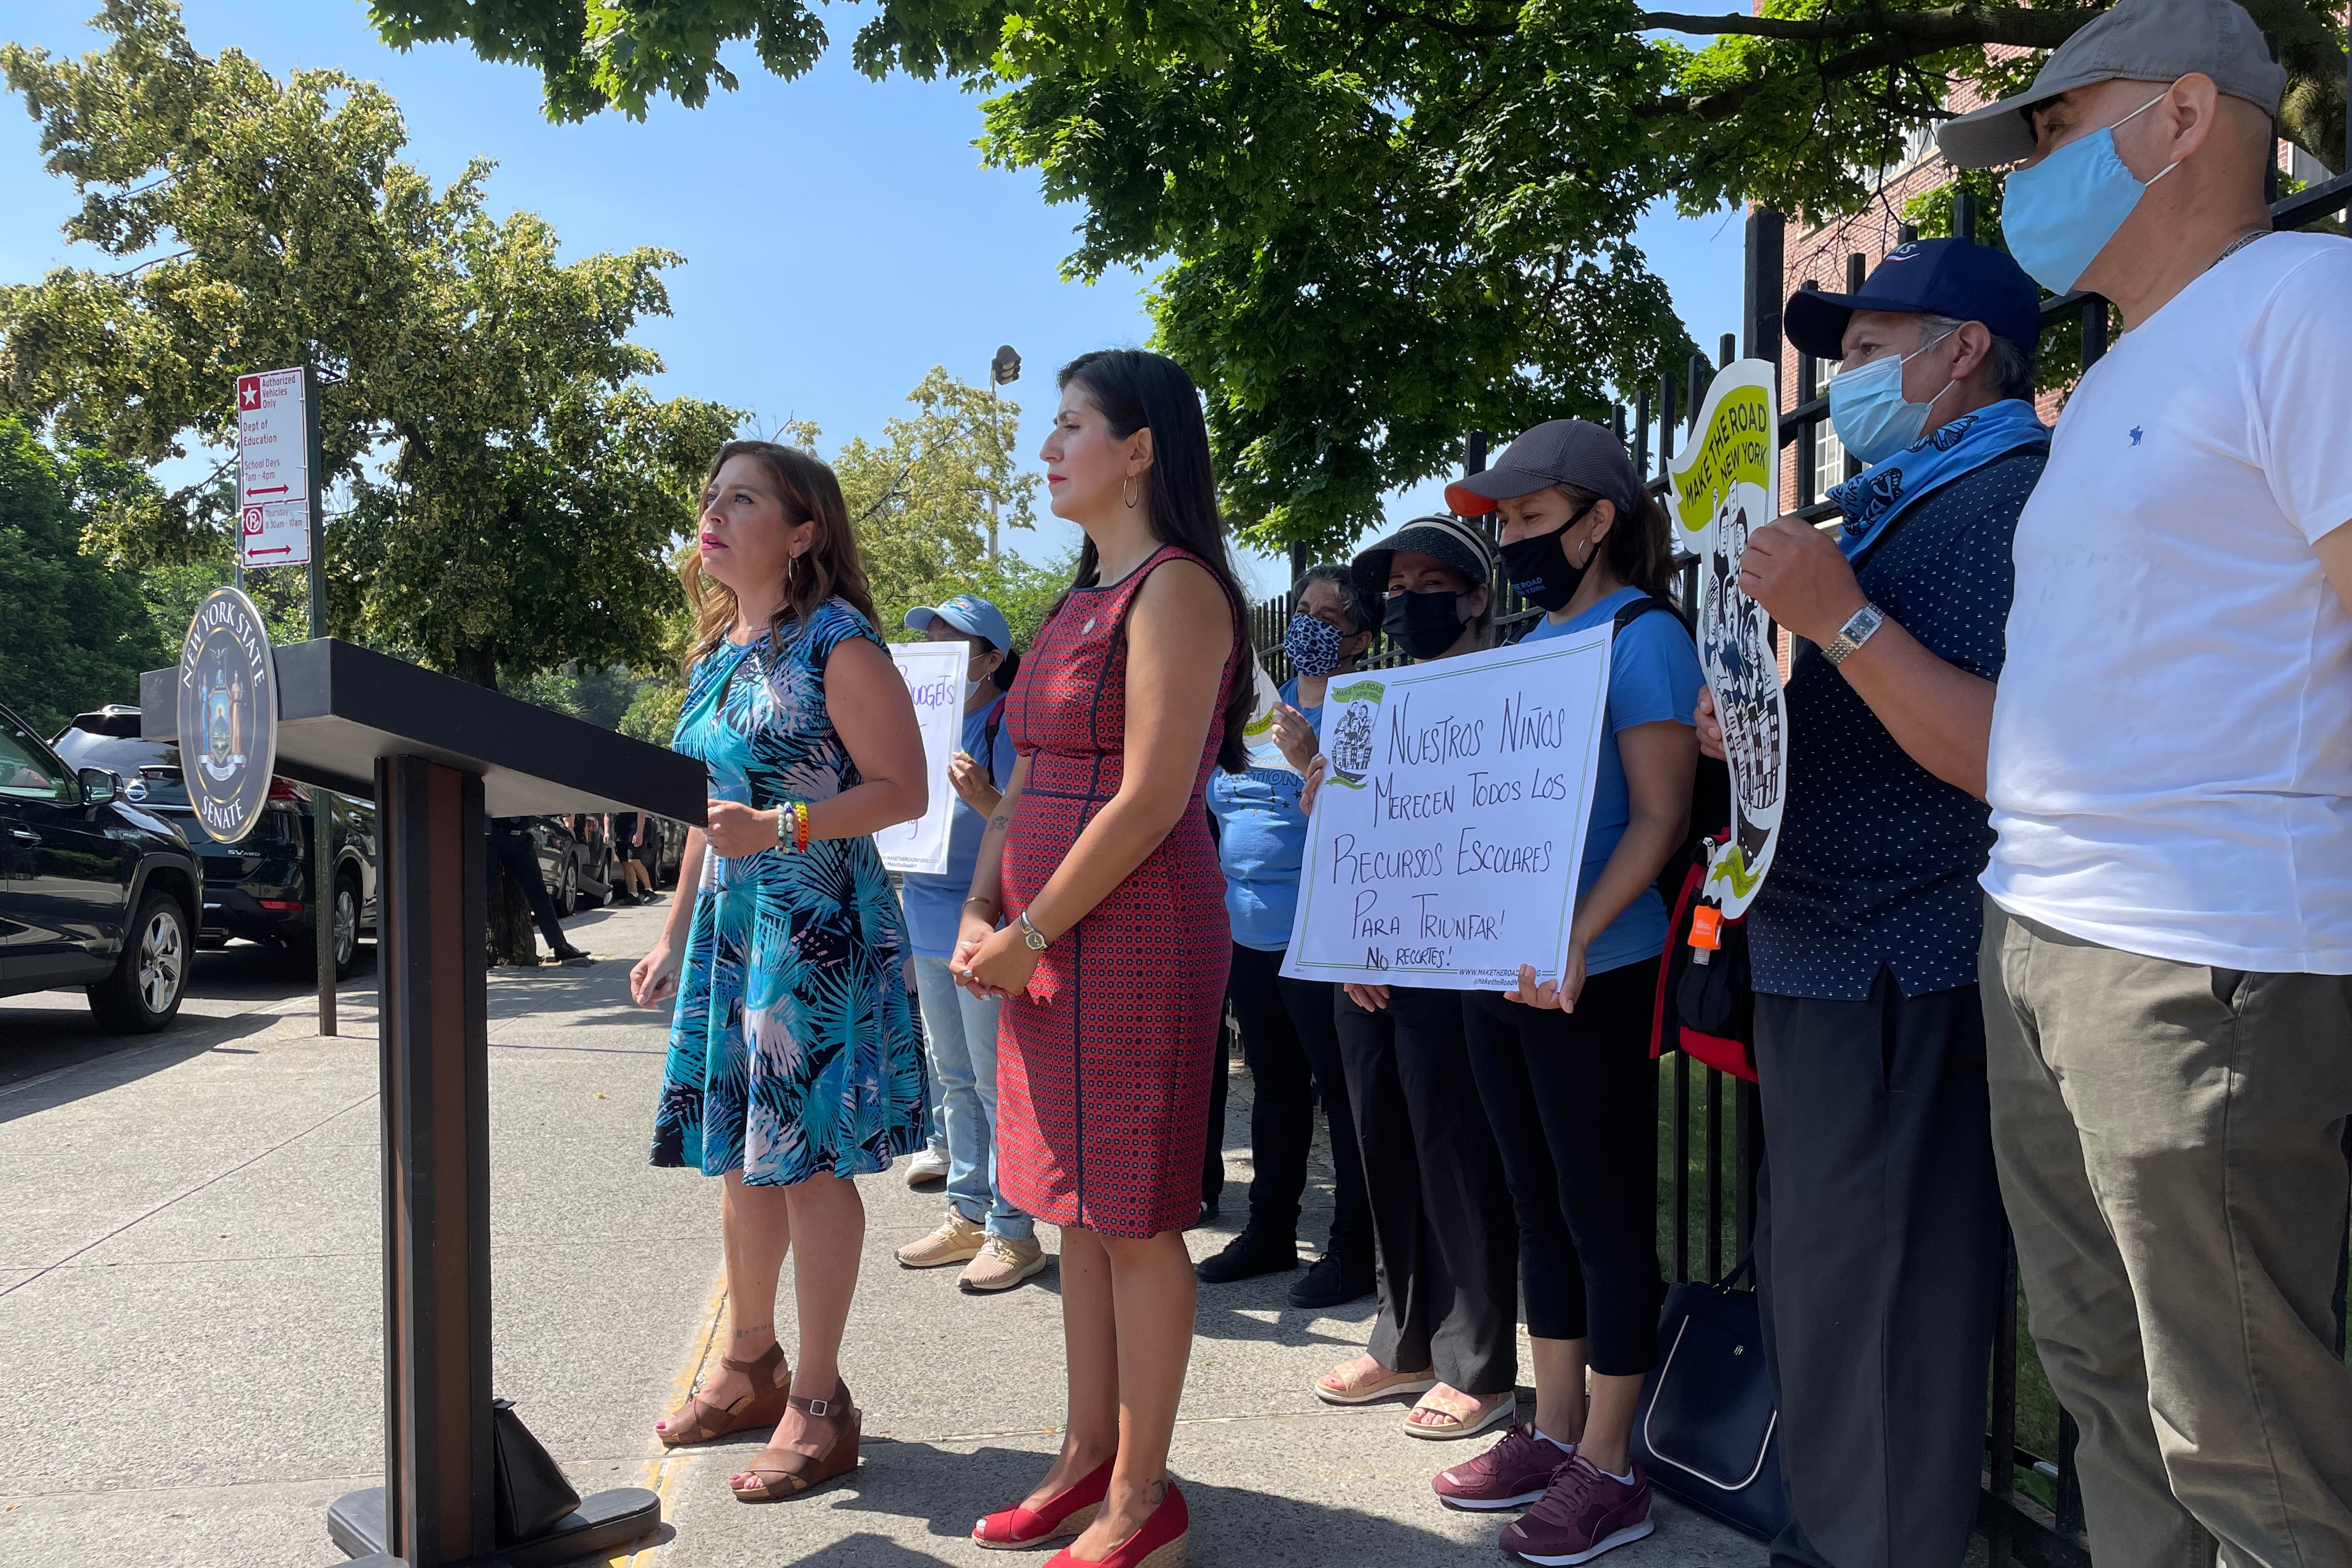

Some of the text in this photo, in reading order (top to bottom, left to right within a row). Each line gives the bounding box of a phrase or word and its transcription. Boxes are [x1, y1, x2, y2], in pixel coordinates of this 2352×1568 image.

[262, 374, 295, 387] Authorized
[262, 387, 287, 398] Vehicles
[262, 399, 276, 410] Only
[243, 419, 268, 432] Dept of
[244, 434, 277, 446] Education
[1686, 402, 1766, 510] MAKE THE ROAD
[244, 459, 280, 470] School Days
[1720, 441, 1767, 486] NEW YORK
[245, 473, 257, 482] 7am
[262, 471, 275, 481] 4pm
[265, 509, 288, 517] Thursday
[265, 521, 284, 529] 8:30am
[289, 519, 302, 527] 10am
[1521, 577, 1542, 589] ROAD
[183, 601, 265, 688] NEW YORK STATE
[1336, 683, 1384, 696] MAKE THE ROAD
[1368, 691, 1381, 701] YORK
[1258, 716, 1272, 729] PODER
[1388, 692, 1483, 765] NUESTROS
[1373, 768, 1566, 828] MERECEN TODOS LOS
[201, 796, 244, 829] SENATE
[1333, 827, 1552, 885] RECURSOS ESCOLARES
[1352, 889, 1505, 941] PARA TRIUNFAR!
[1395, 946, 1452, 968] RECORTES!
